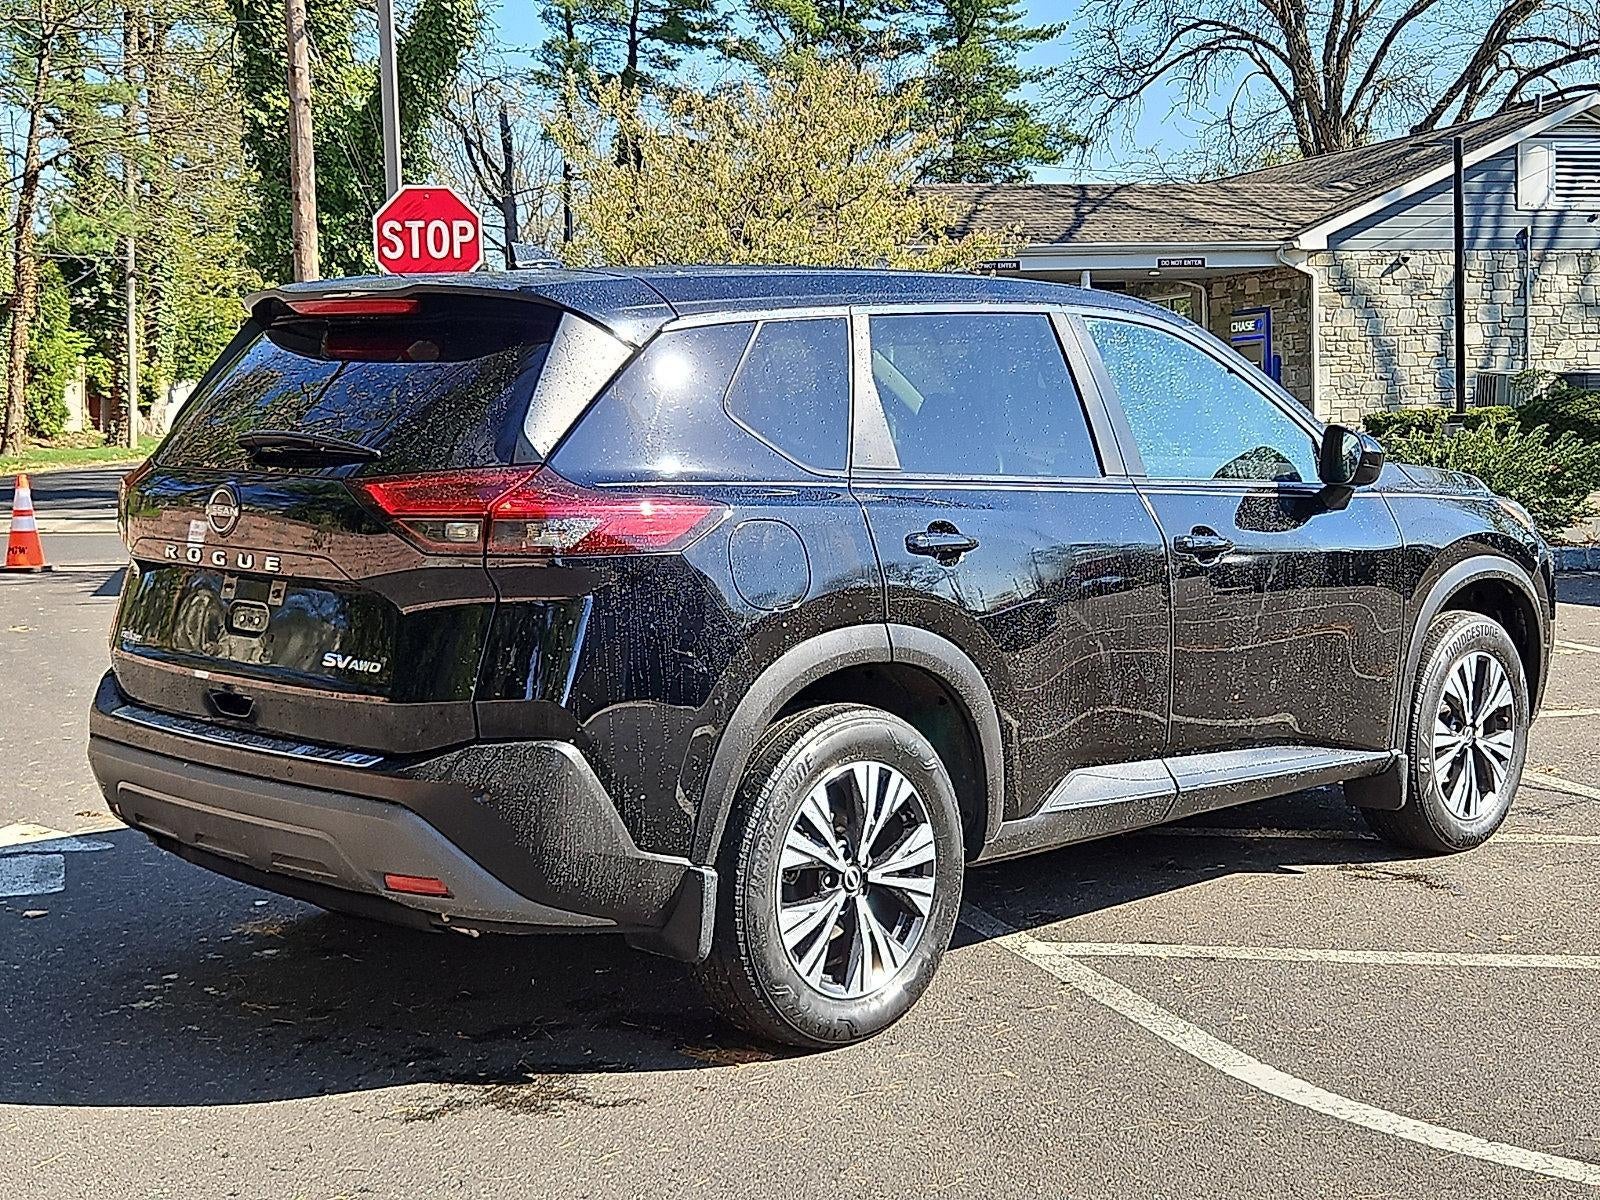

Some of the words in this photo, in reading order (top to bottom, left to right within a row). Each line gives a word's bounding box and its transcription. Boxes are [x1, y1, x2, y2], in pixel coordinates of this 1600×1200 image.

[381, 220, 475, 260] STOP
[1231, 320, 1256, 332] CHASE
[164, 543, 281, 572] ROGUE
[321, 652, 353, 669] SV
[348, 659, 382, 673] AWD
